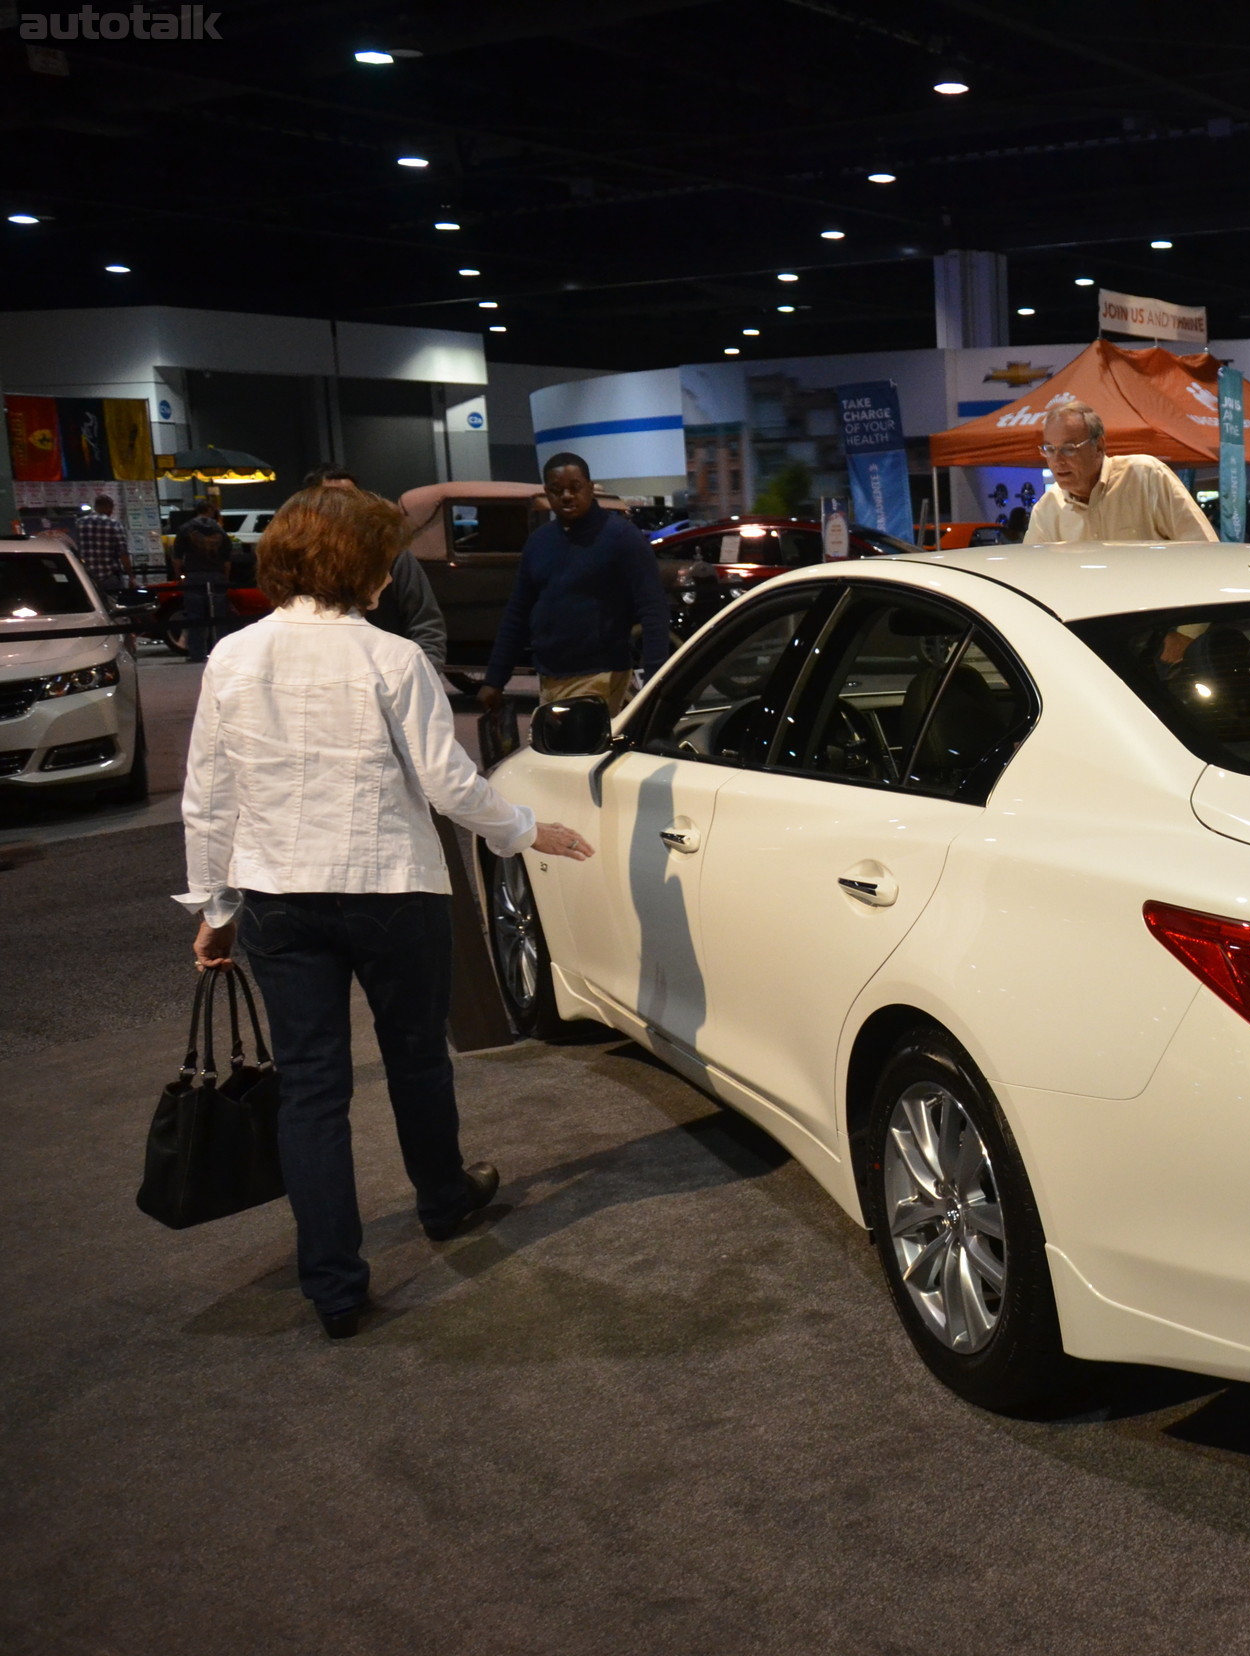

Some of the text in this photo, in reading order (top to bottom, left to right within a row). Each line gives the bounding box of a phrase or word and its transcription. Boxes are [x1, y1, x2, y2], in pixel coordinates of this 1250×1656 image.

[1102, 300, 1128, 321] JOIN
[1131, 308, 1145, 324] US
[1146, 310, 1169, 328] AND
[842, 397, 872, 410] TAKE
[843, 408, 892, 422] CHARGE
[845, 419, 895, 434] OF YOUR
[846, 432, 889, 446] HEALTH
